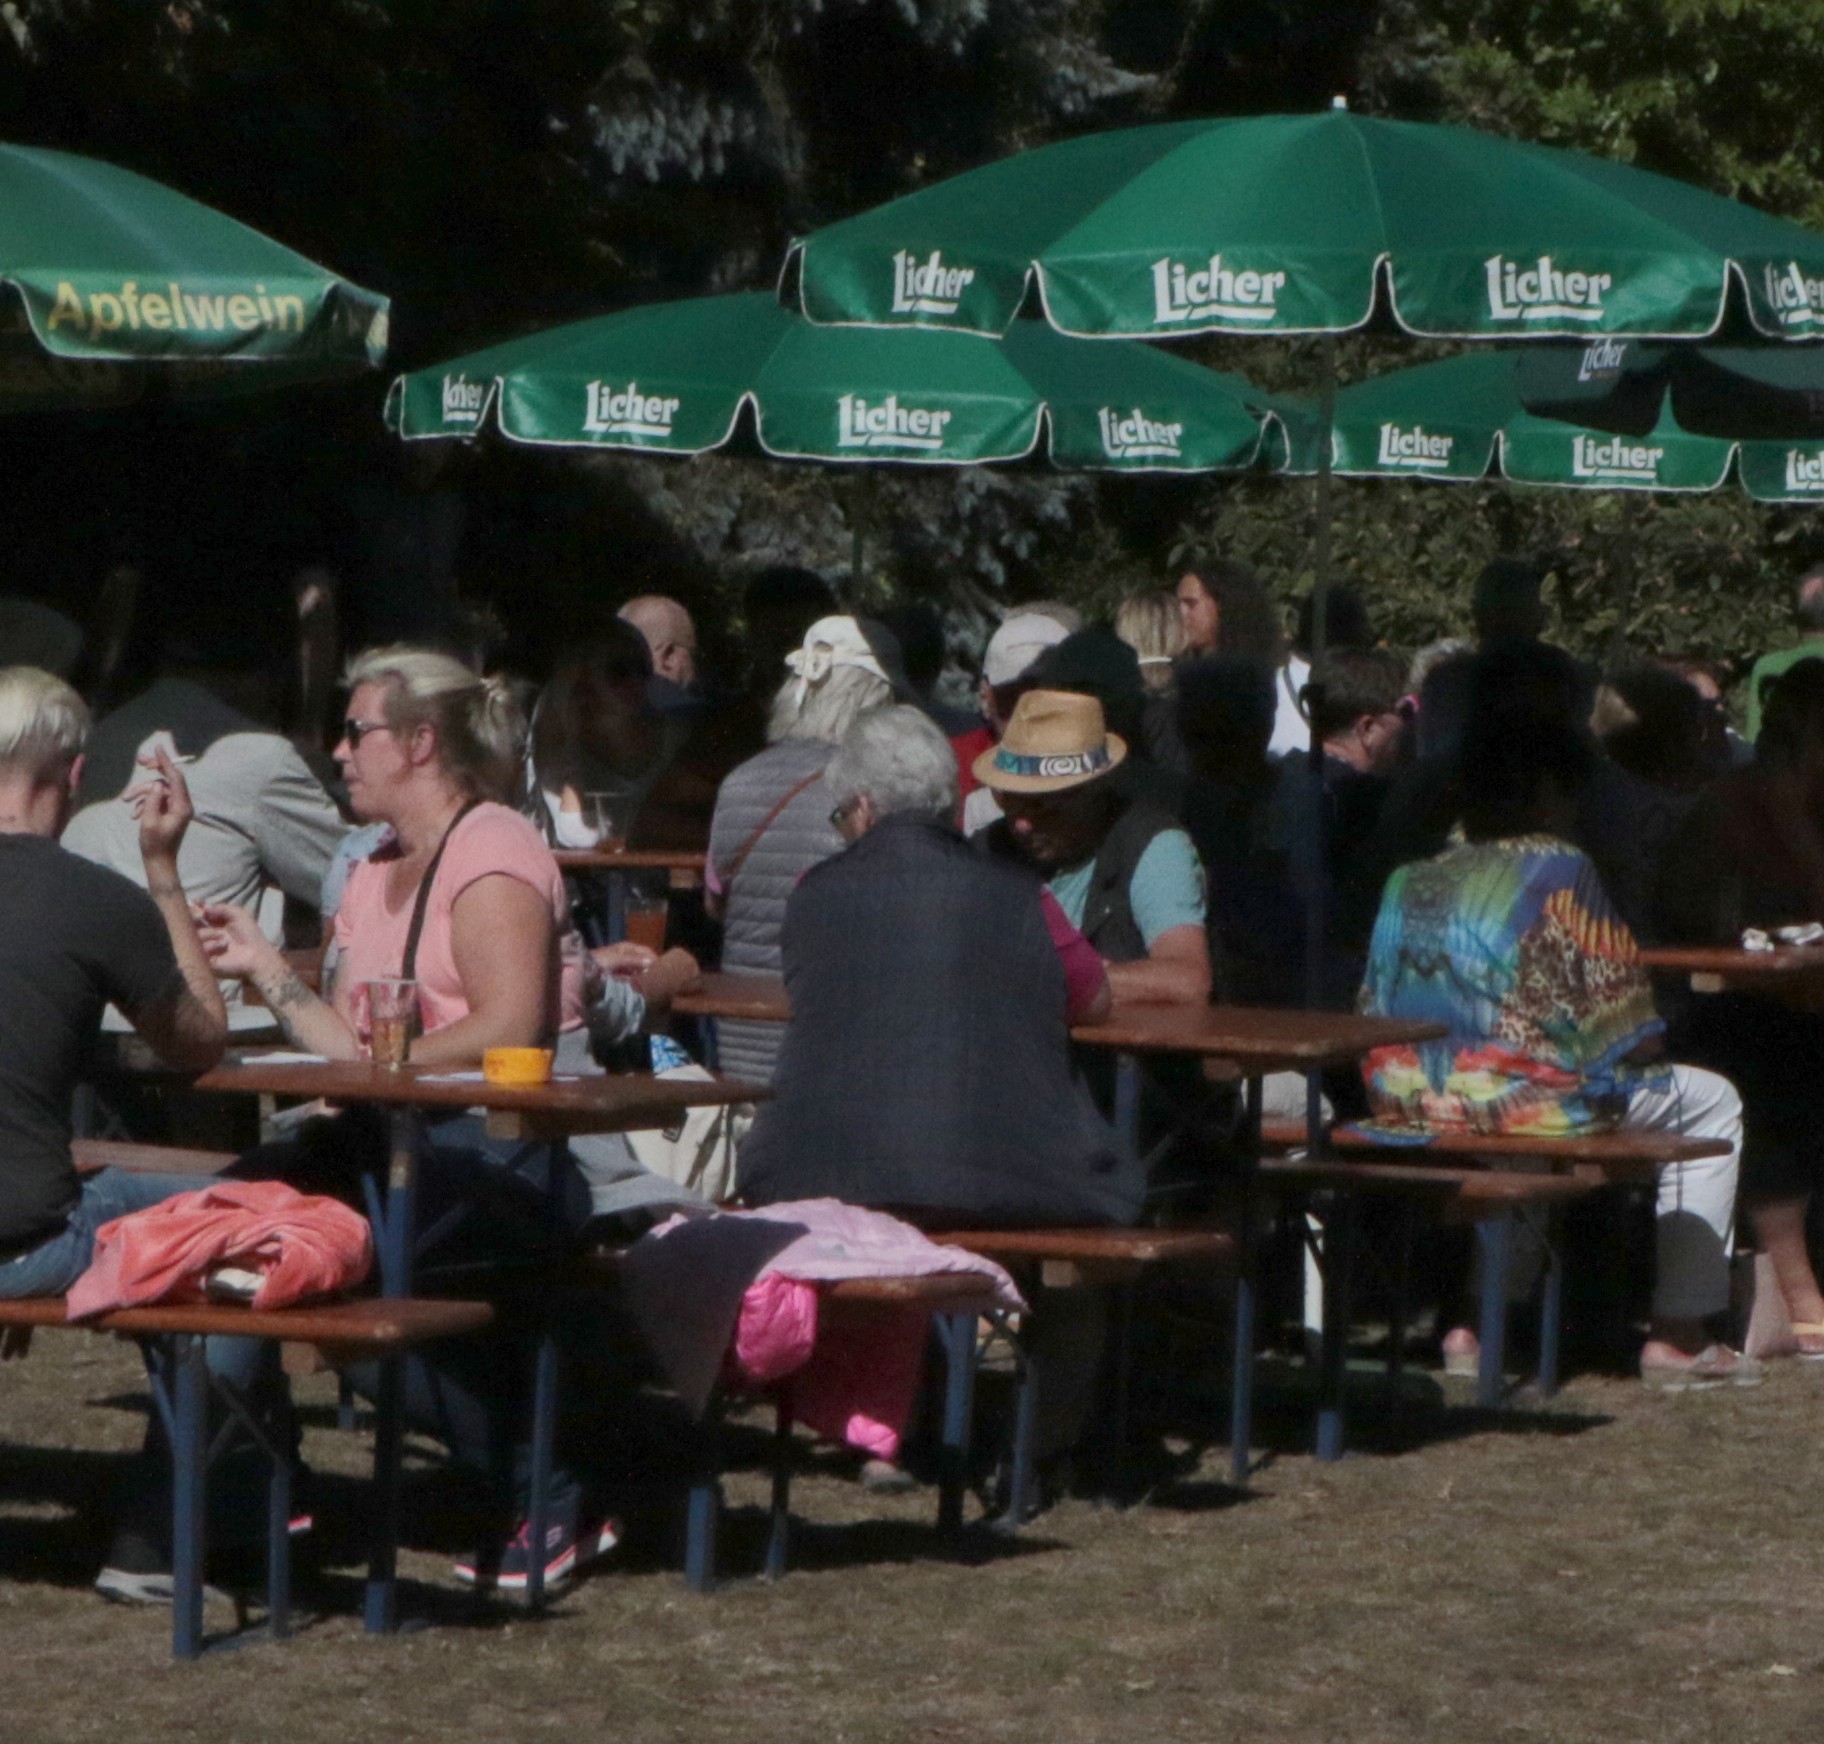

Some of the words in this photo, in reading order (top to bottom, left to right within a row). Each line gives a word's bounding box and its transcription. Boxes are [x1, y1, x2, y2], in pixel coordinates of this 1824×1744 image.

[48, 279, 305, 340] Apfelwein
[892, 249, 975, 315] Licher
[1150, 253, 1286, 324] Licher
[1484, 254, 1612, 322] Licher
[584, 381, 679, 437] Licher
[837, 393, 951, 448] Licher
[1098, 408, 1182, 458] Licher
[1379, 422, 1454, 468] Licher
[1571, 435, 1664, 479] Licher
